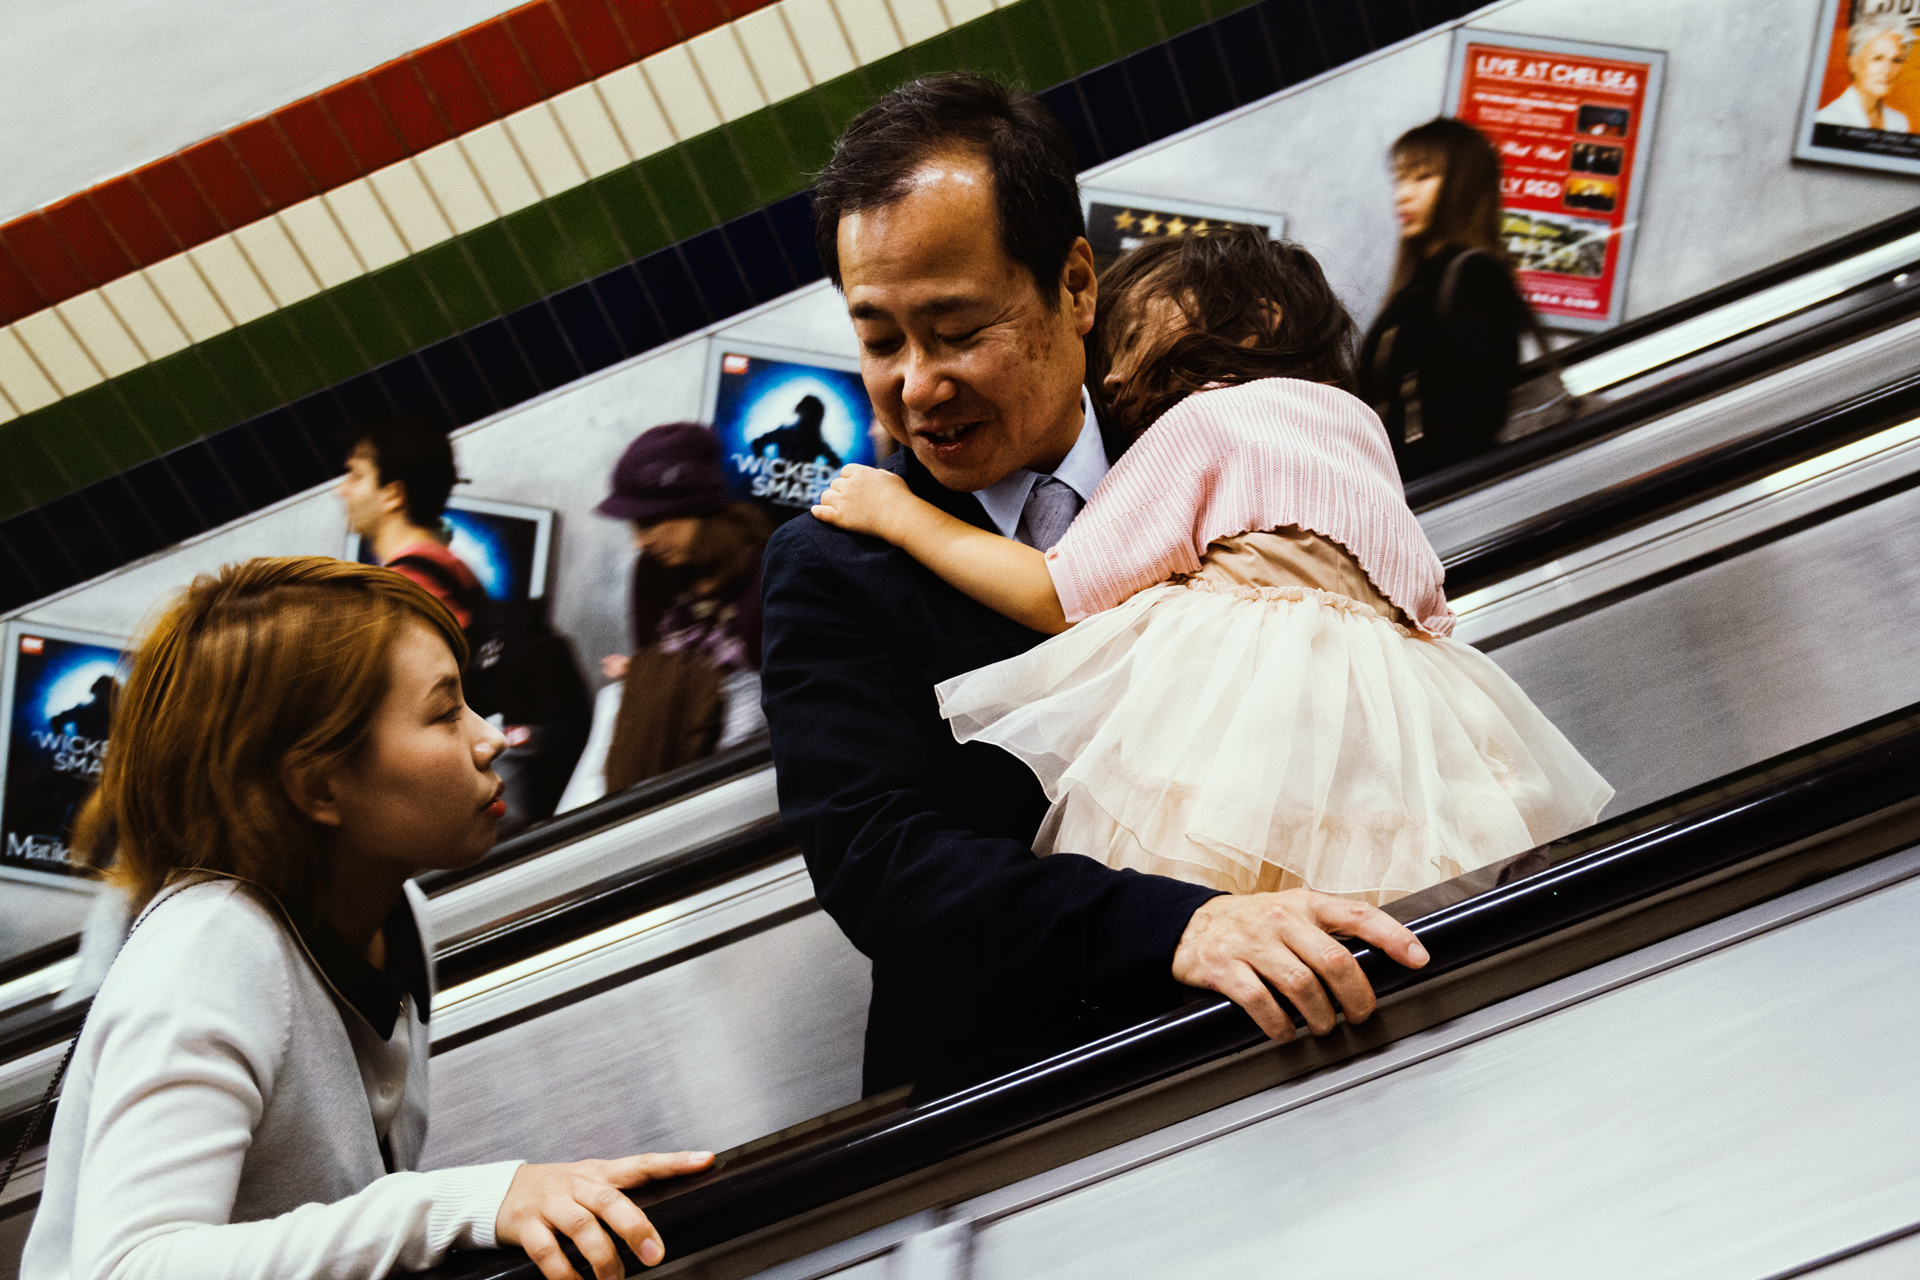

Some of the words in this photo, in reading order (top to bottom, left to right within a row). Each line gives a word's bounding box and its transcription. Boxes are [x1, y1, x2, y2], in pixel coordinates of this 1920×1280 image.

[1475, 55, 1519, 76] LIVE
[1522, 60, 1551, 80] AT
[1550, 64, 1639, 90] CHELSEA
[731, 453, 835, 486] WICKED
[749, 474, 823, 505] SMAR
[52, 751, 103, 775] SMA
